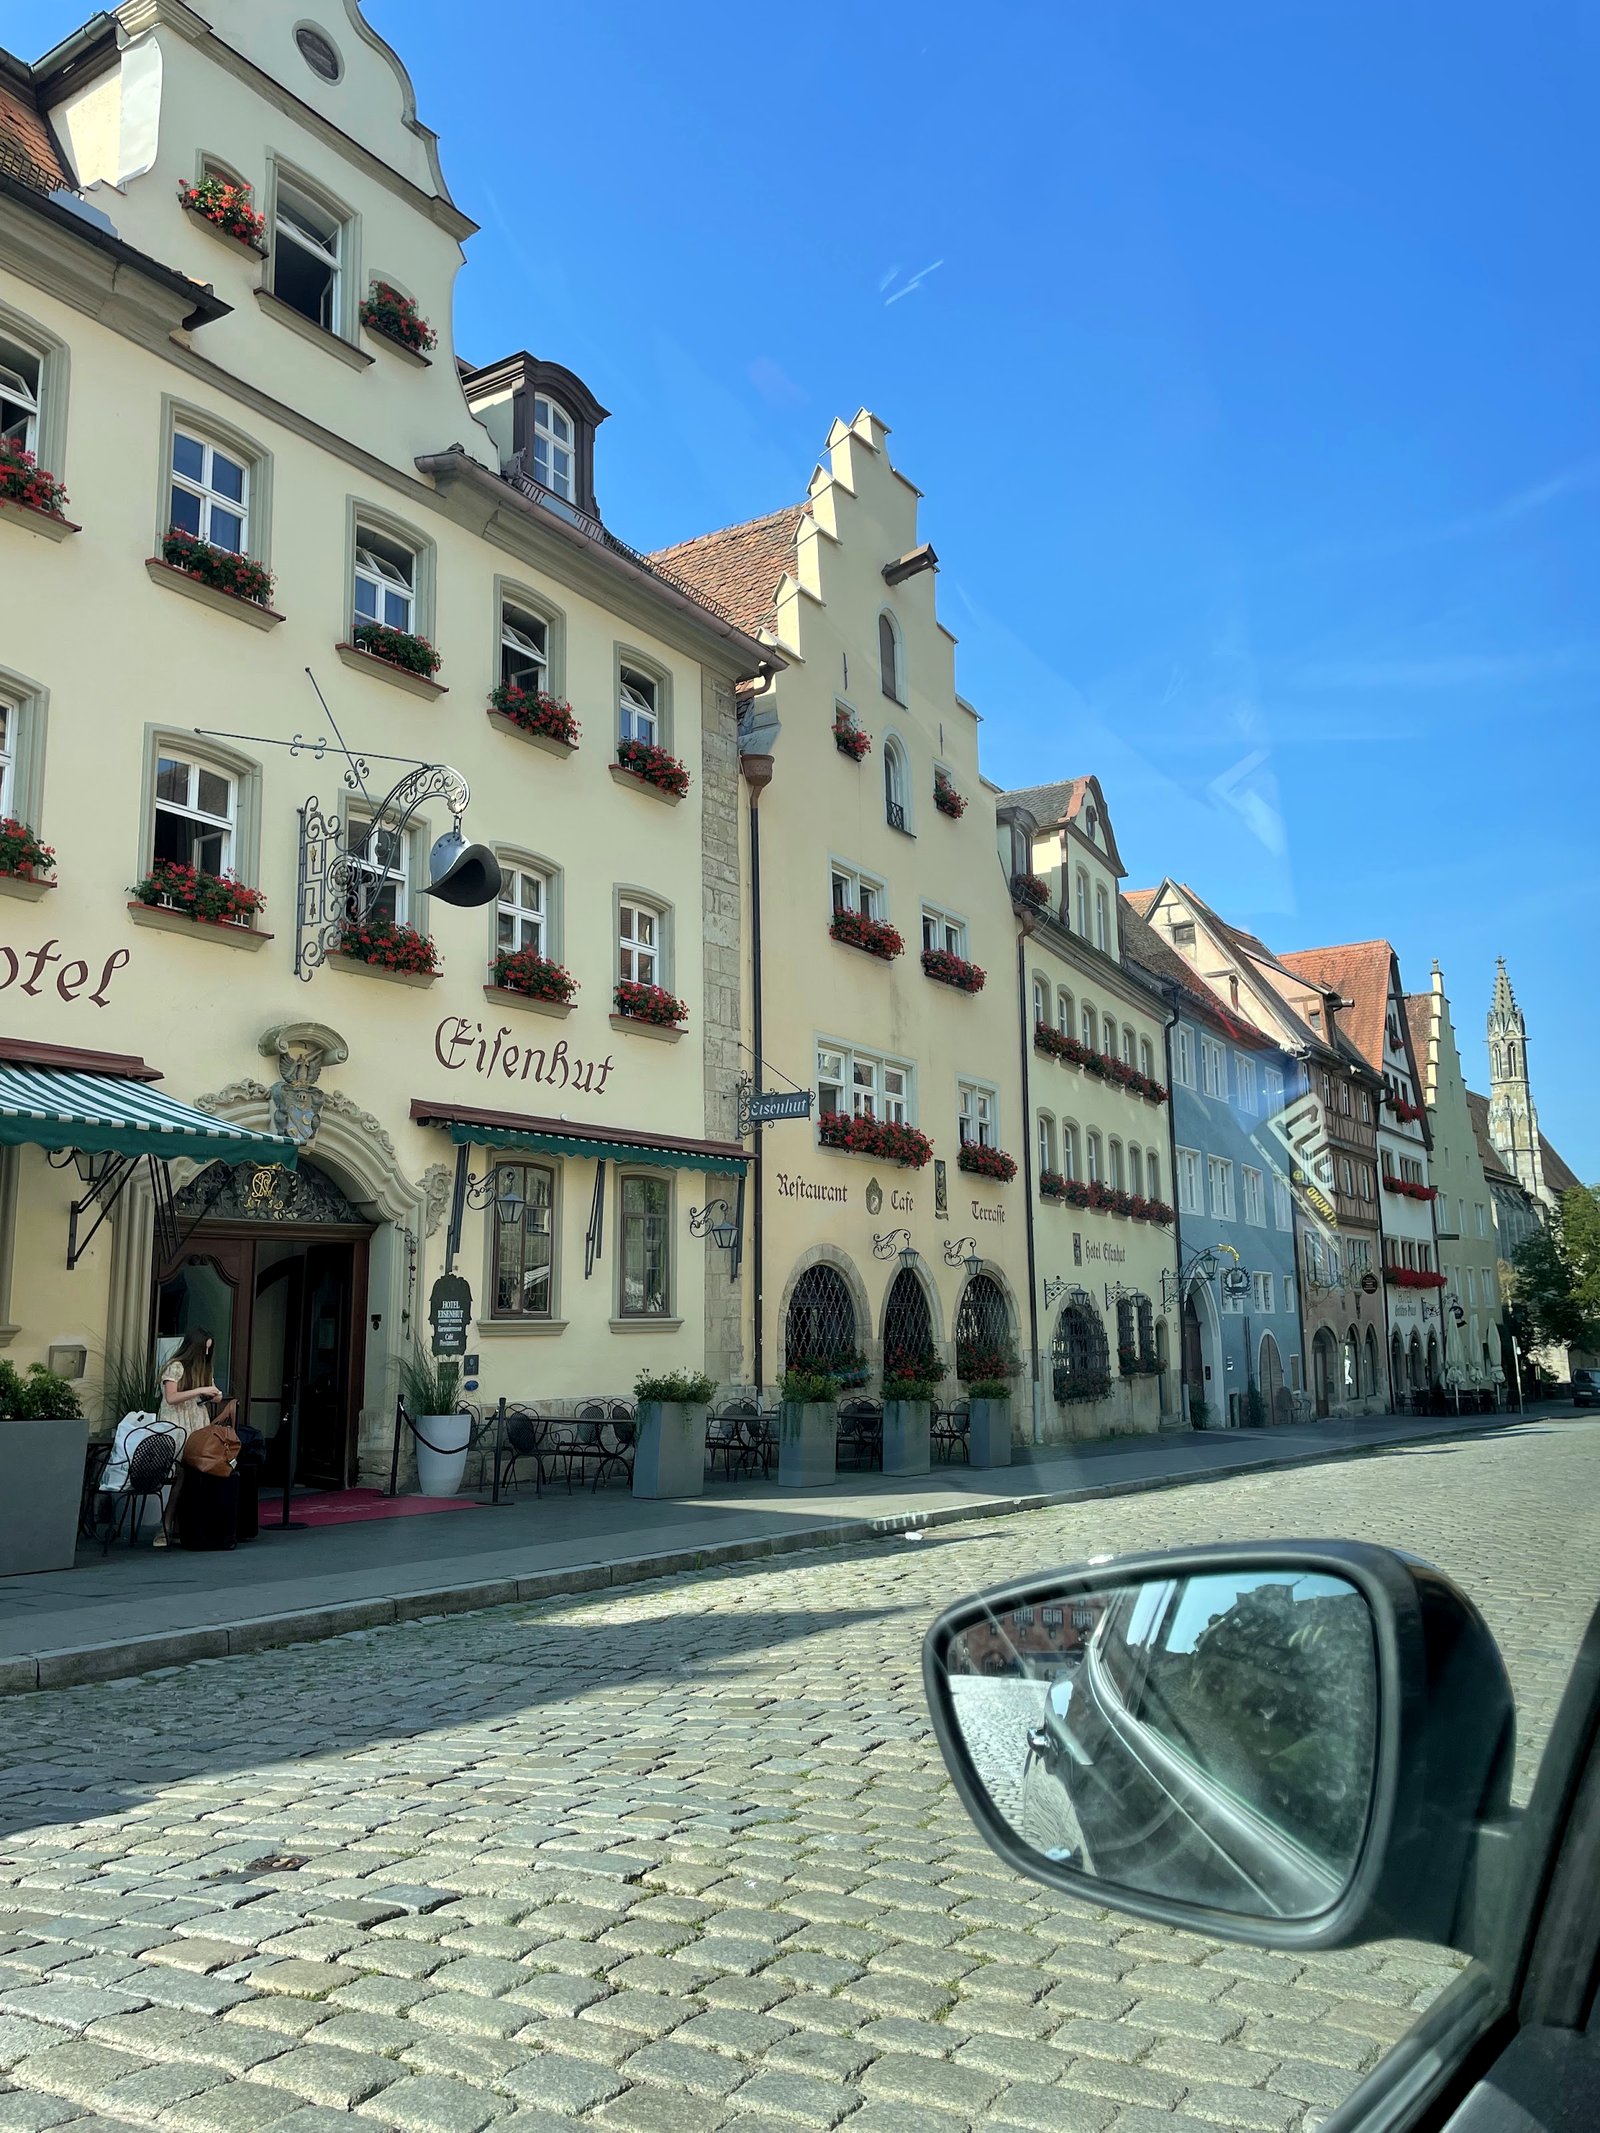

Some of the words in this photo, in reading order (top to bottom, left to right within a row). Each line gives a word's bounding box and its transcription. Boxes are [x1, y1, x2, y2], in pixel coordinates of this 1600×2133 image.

[751, 1099, 807, 1116] Eisenhut
[776, 1172, 848, 1203] Restaurant
[1085, 1239, 1101, 1264] Hotel
[442, 1300, 461, 1309] HOTEL
[437, 1310, 463, 1319] EISENHUT
